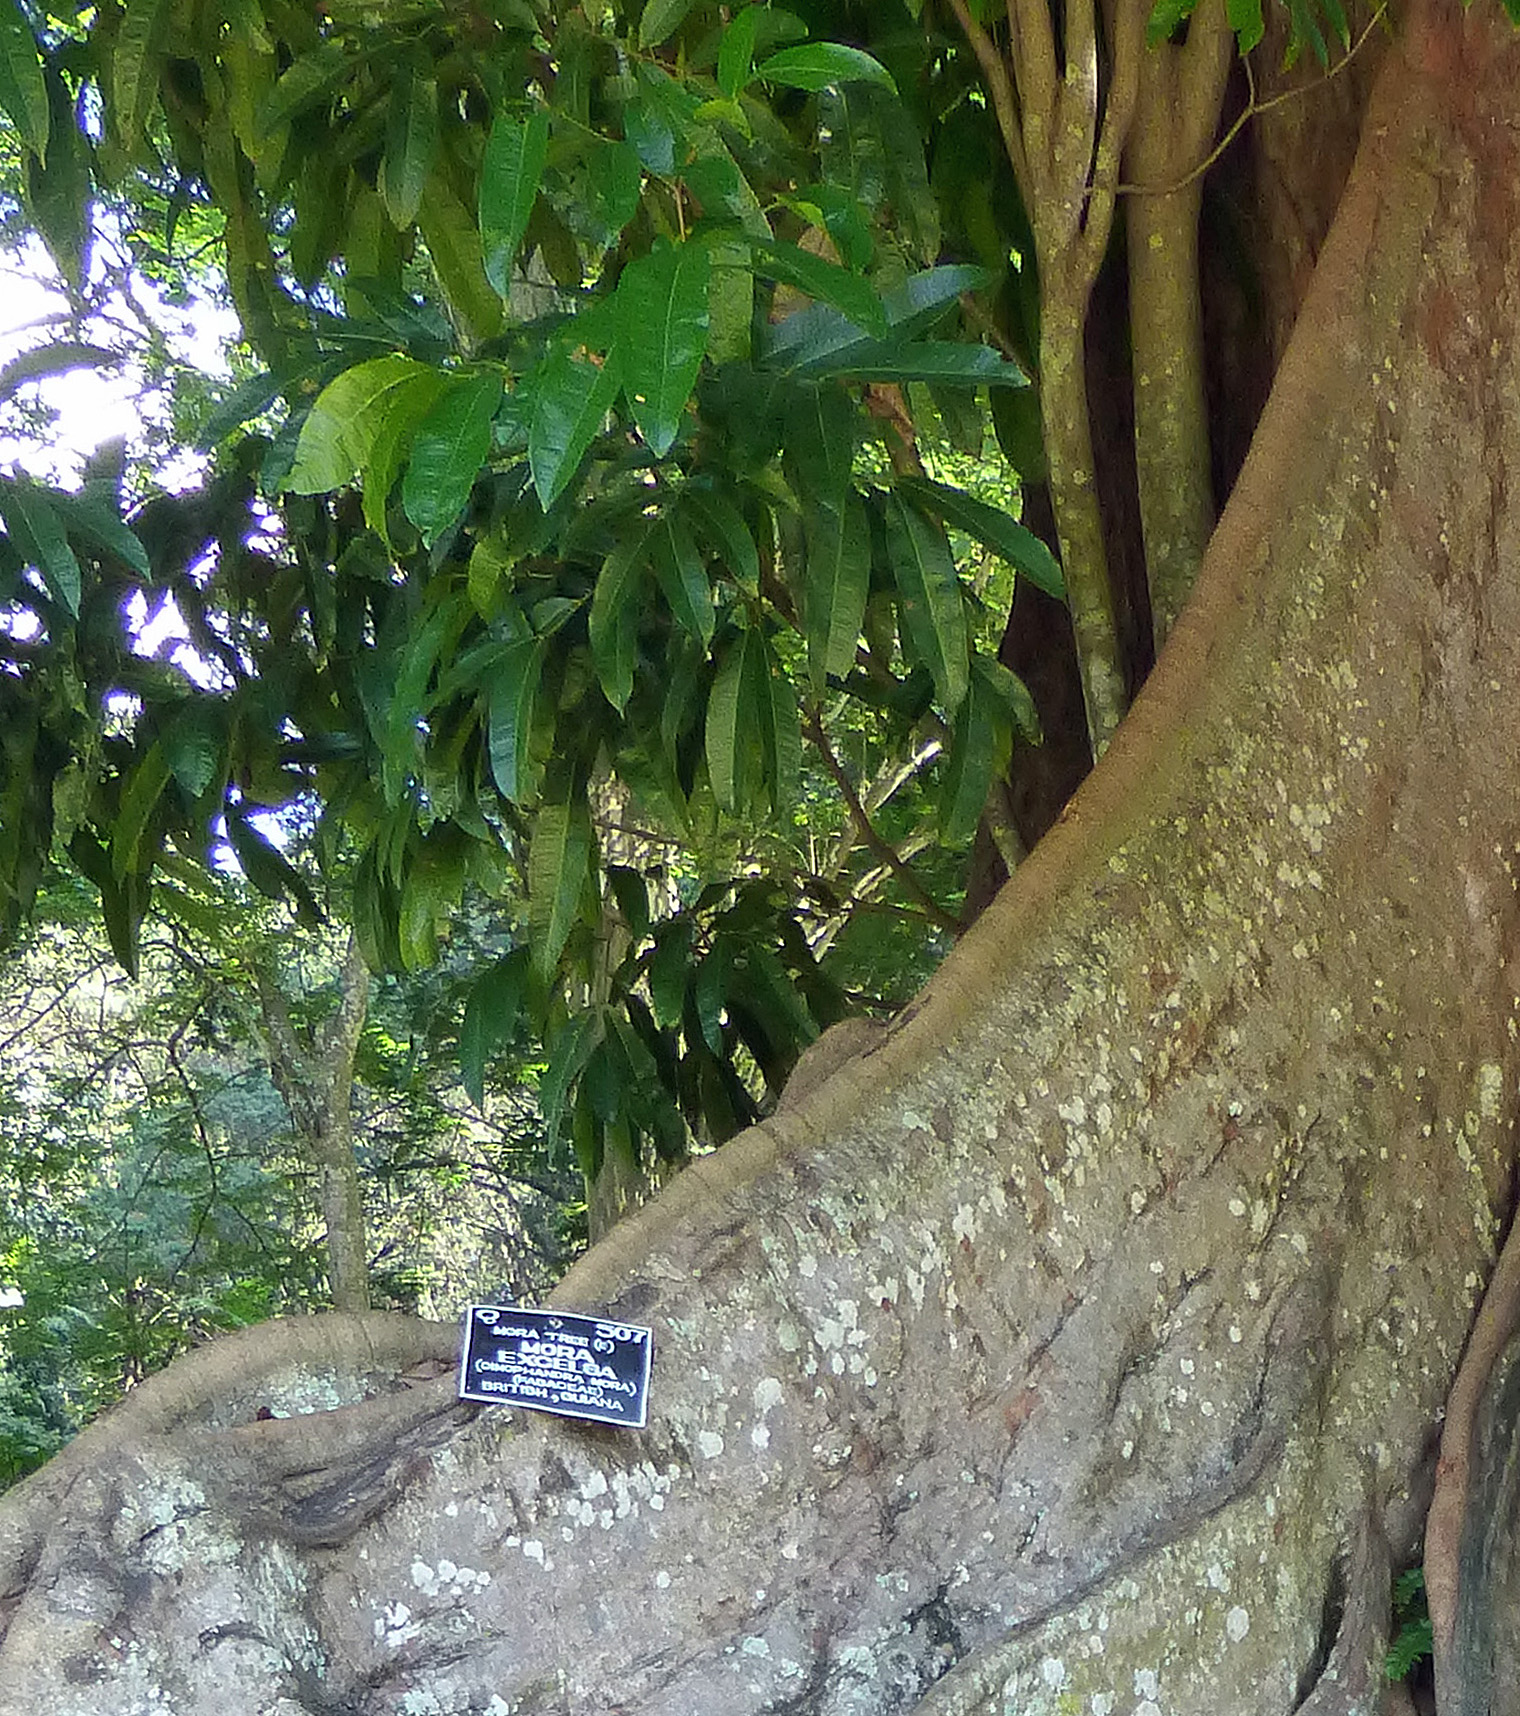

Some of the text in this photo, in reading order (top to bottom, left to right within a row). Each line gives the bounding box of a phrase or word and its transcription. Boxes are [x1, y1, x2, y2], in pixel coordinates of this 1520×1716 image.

[492, 1326, 540, 1340] MORA
[543, 1331, 590, 1347] TREE
[596, 1323, 647, 1344] 507
[520, 1340, 595, 1363] MORA
[497, 1349, 618, 1379] EXCELSA
